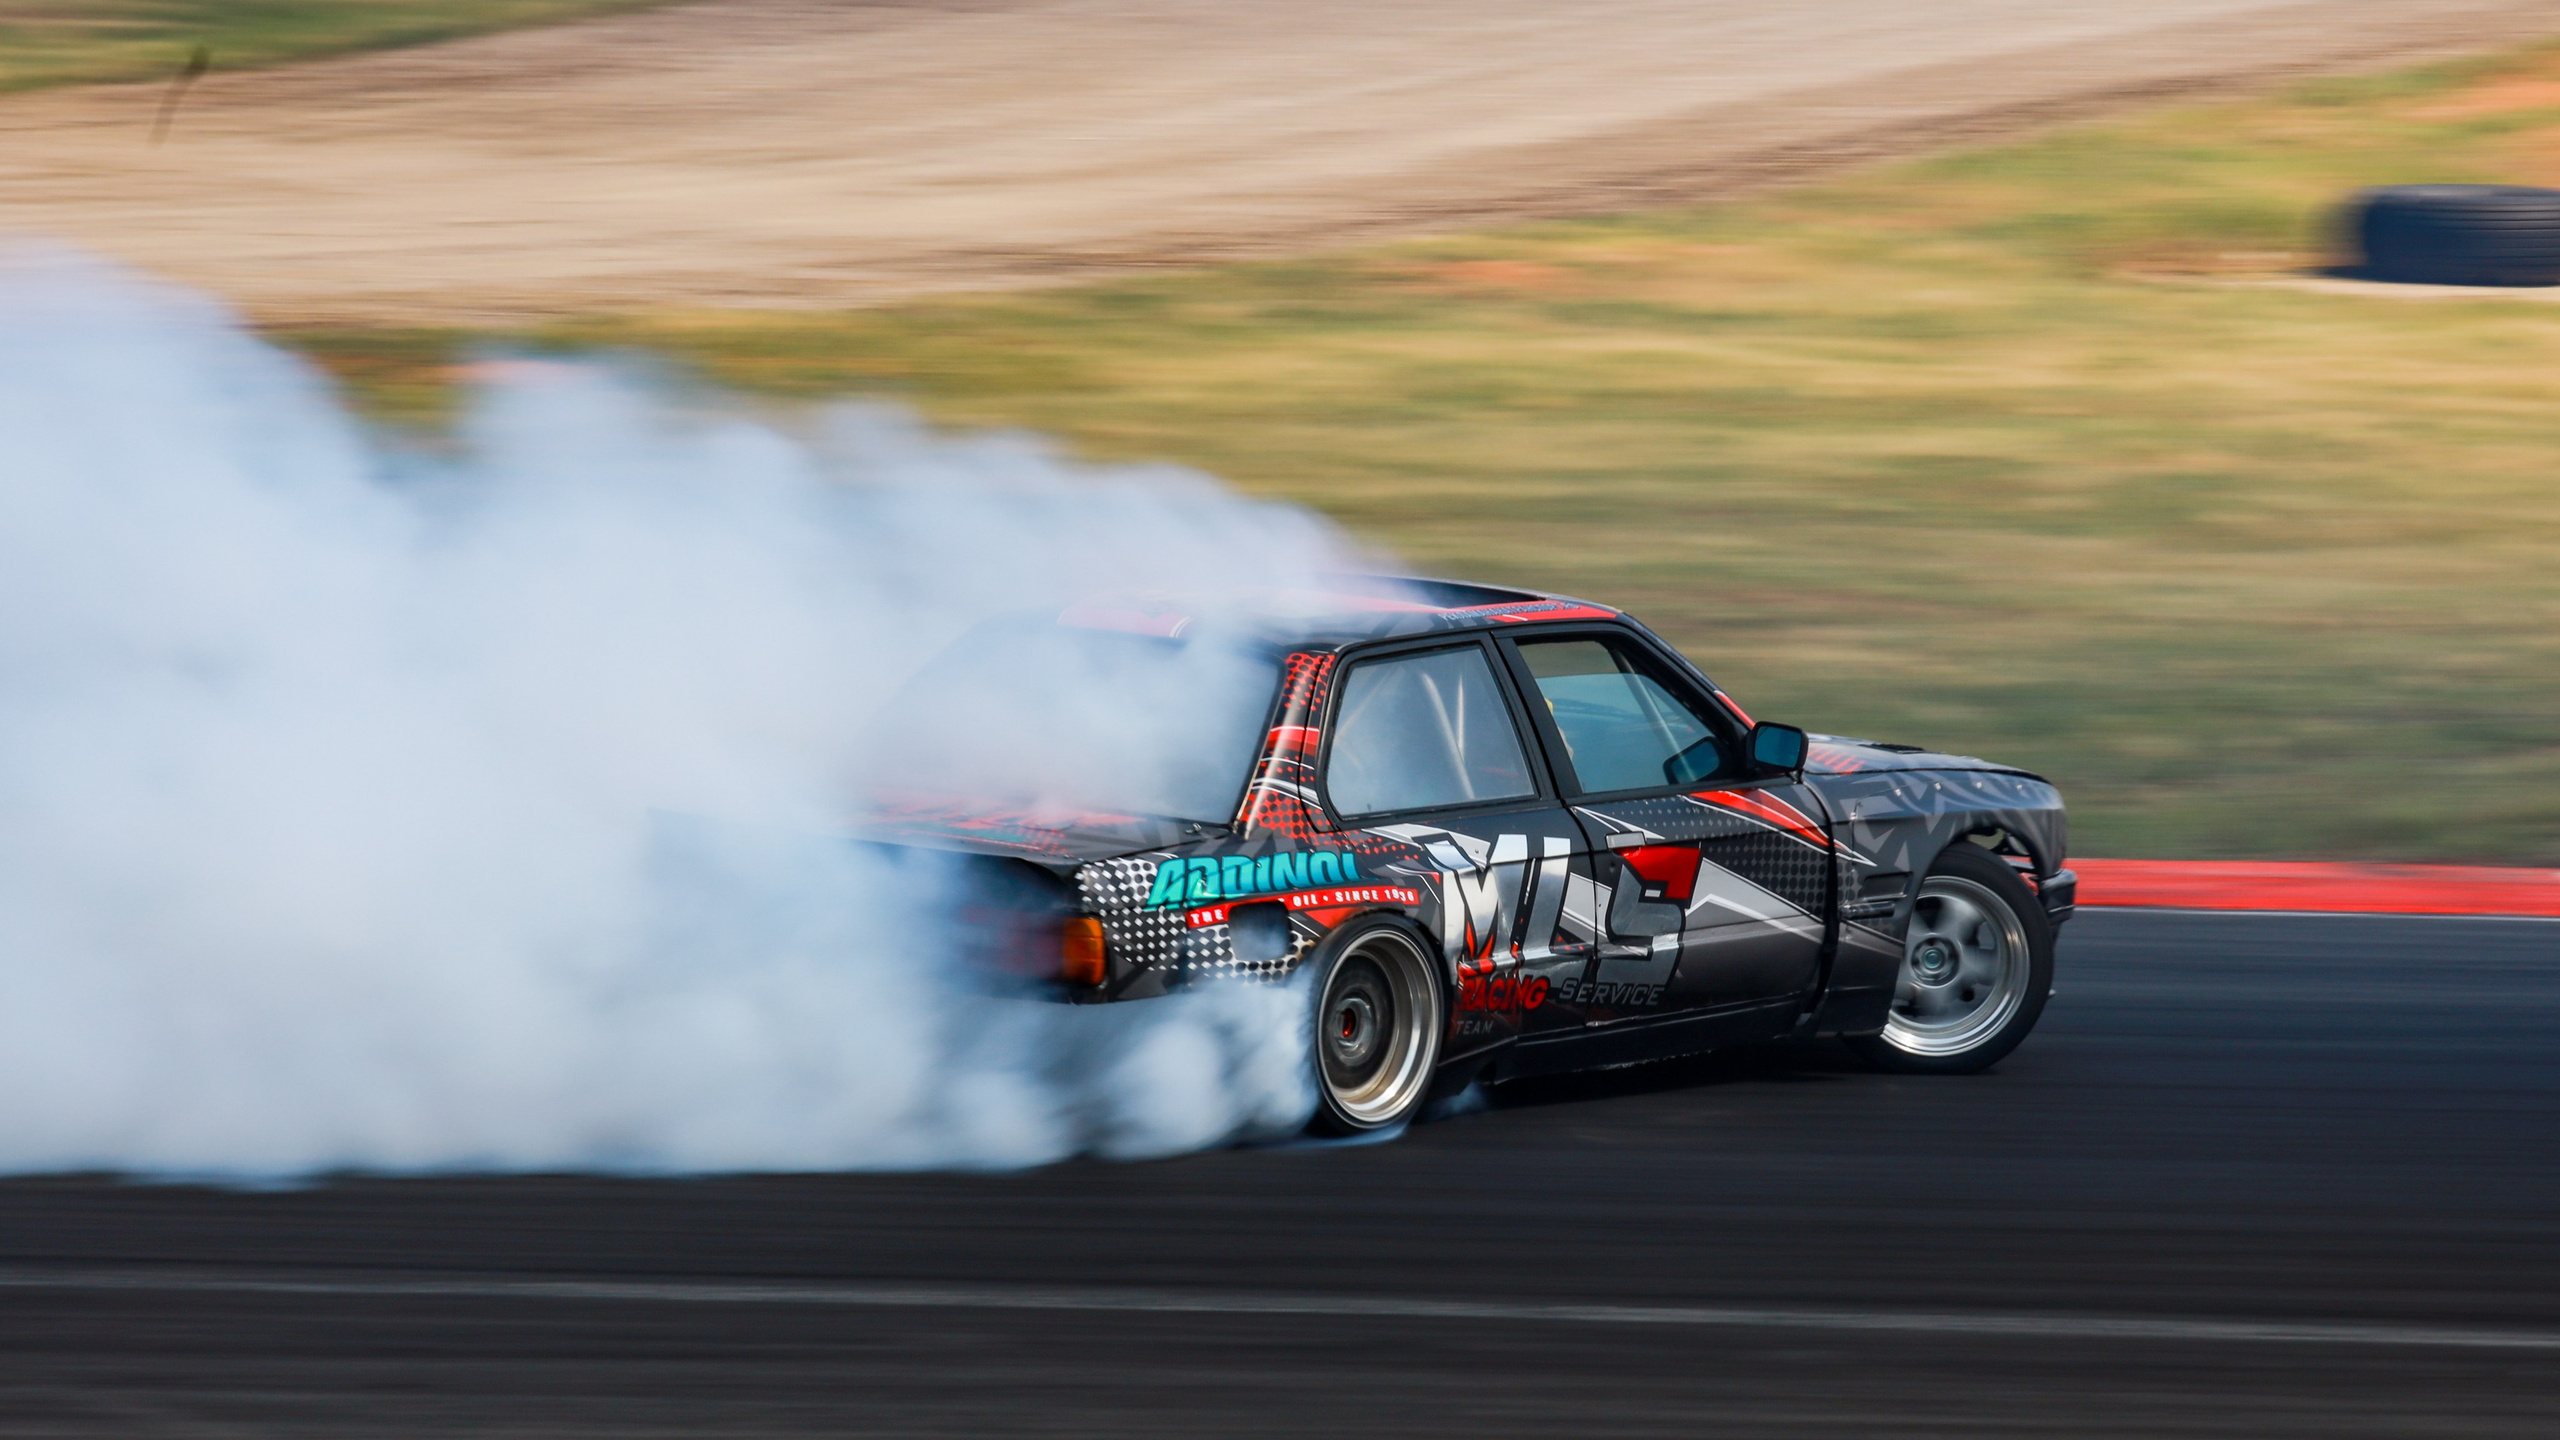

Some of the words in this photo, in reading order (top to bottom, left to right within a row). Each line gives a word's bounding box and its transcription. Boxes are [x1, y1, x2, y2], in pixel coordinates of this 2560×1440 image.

[1190, 909, 1224, 925] THE
[1293, 893, 1318, 907] OIL
[1335, 888, 1379, 903] SINCE
[1383, 887, 1415, 903] 1936
[1459, 975, 1550, 1012] RACING
[1559, 979, 1665, 1006] SERVICE
[1456, 1020, 1494, 1036] TEAM
